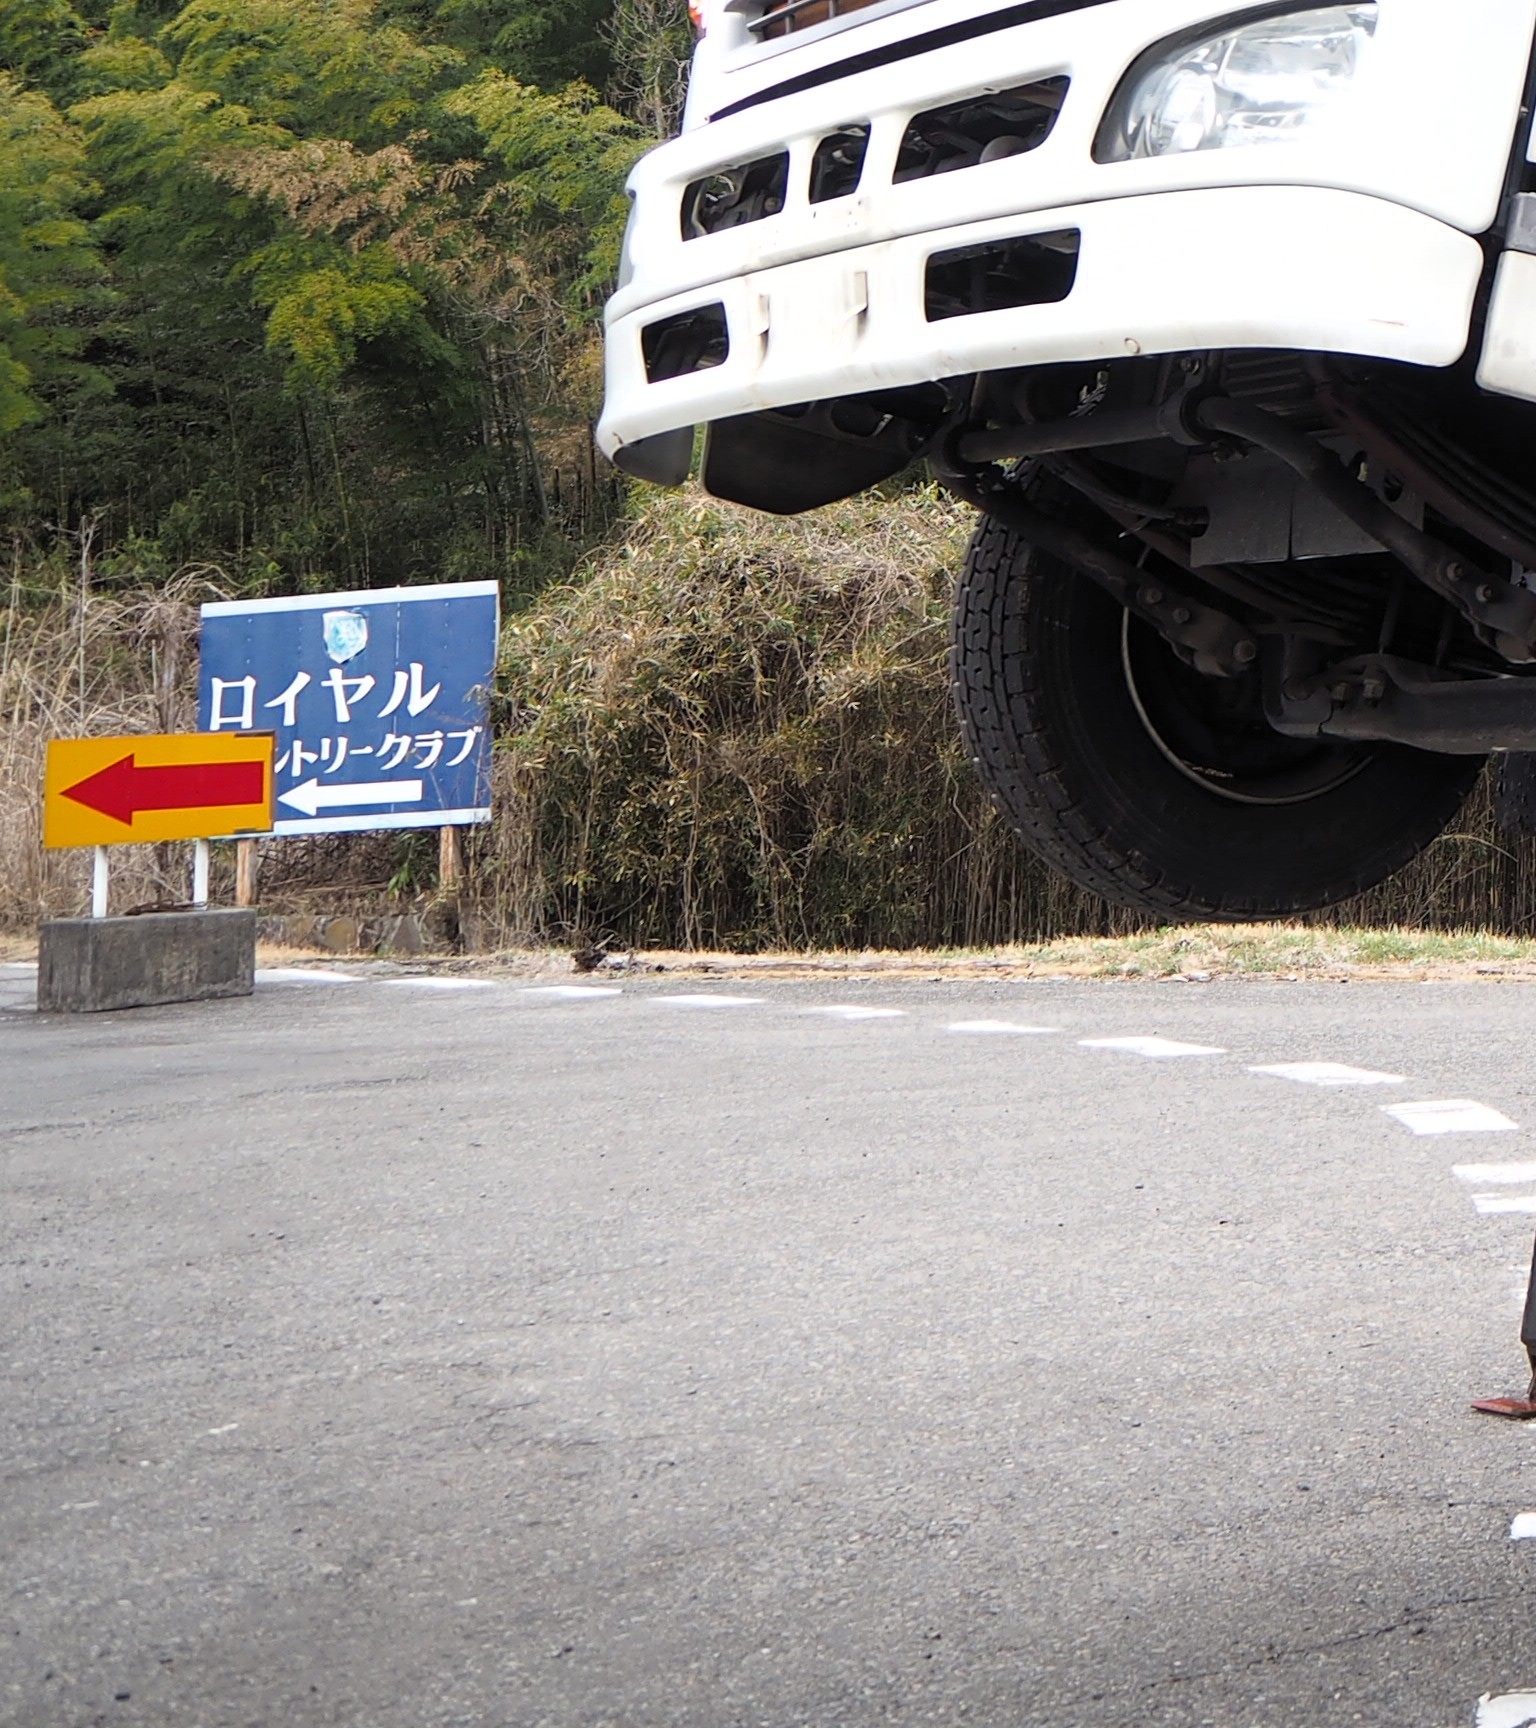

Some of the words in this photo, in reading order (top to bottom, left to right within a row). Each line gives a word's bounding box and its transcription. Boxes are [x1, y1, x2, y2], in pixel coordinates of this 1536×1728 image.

[209, 662, 441, 731] ロイヤル
[274, 726, 483, 777] ントリークラブ
